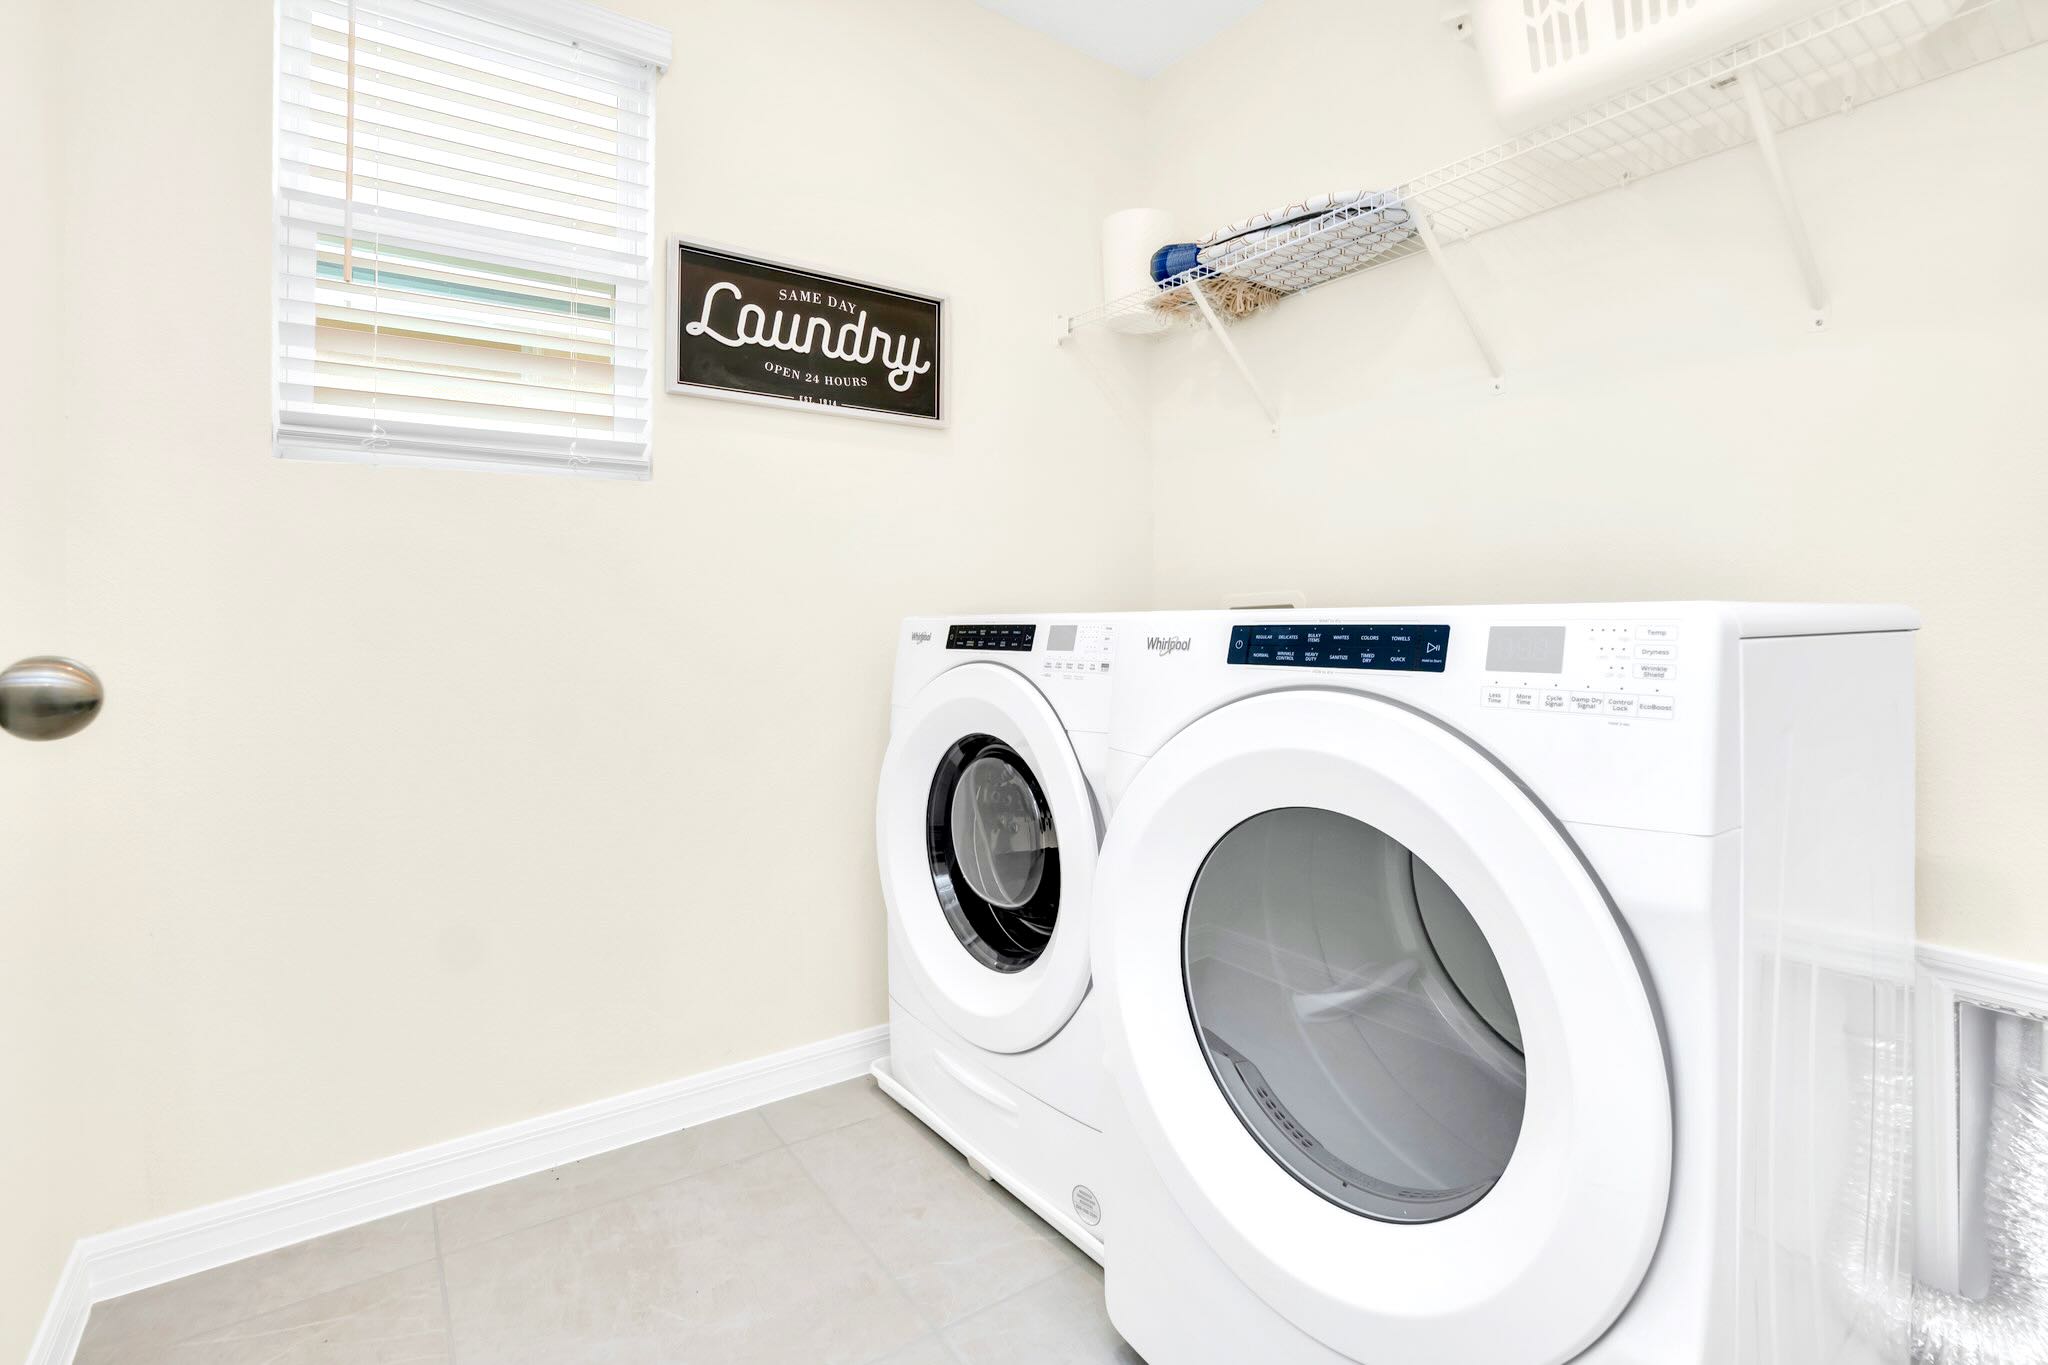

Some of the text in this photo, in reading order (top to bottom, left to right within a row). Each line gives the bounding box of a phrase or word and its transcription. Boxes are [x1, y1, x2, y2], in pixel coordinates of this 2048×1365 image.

[779, 288, 857, 315] SAME DAY
[685, 281, 931, 392] Laundry
[764, 361, 868, 387] OPEN 24 HOURS
[1147, 636, 1191, 656] Whirlpool
[1591, 697, 1602, 705] Dry
